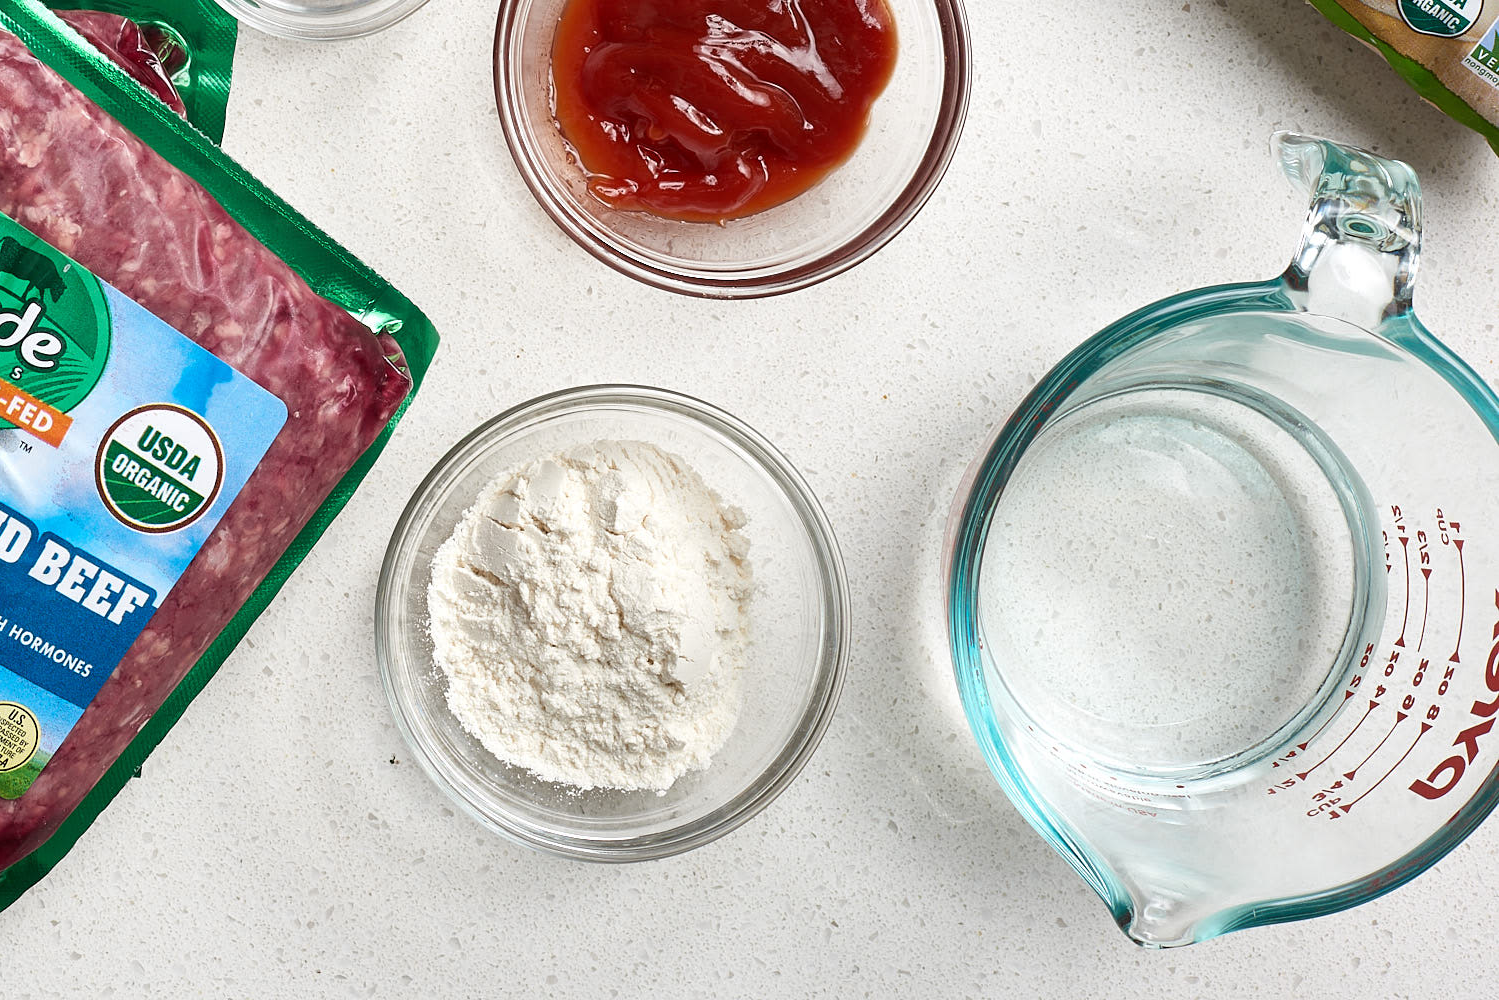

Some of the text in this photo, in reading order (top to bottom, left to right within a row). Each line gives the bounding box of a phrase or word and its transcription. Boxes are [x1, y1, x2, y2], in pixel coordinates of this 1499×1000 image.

[137, 425, 201, 482] USDA
[112, 454, 190, 512] ORGANIC
[28, 538, 151, 626] BEEF
[8, 624, 94, 678] HORMONES
[8, 708, 26, 727] U.S.
[19, 740, 29, 748] BY
[16, 746, 25, 754] OF
